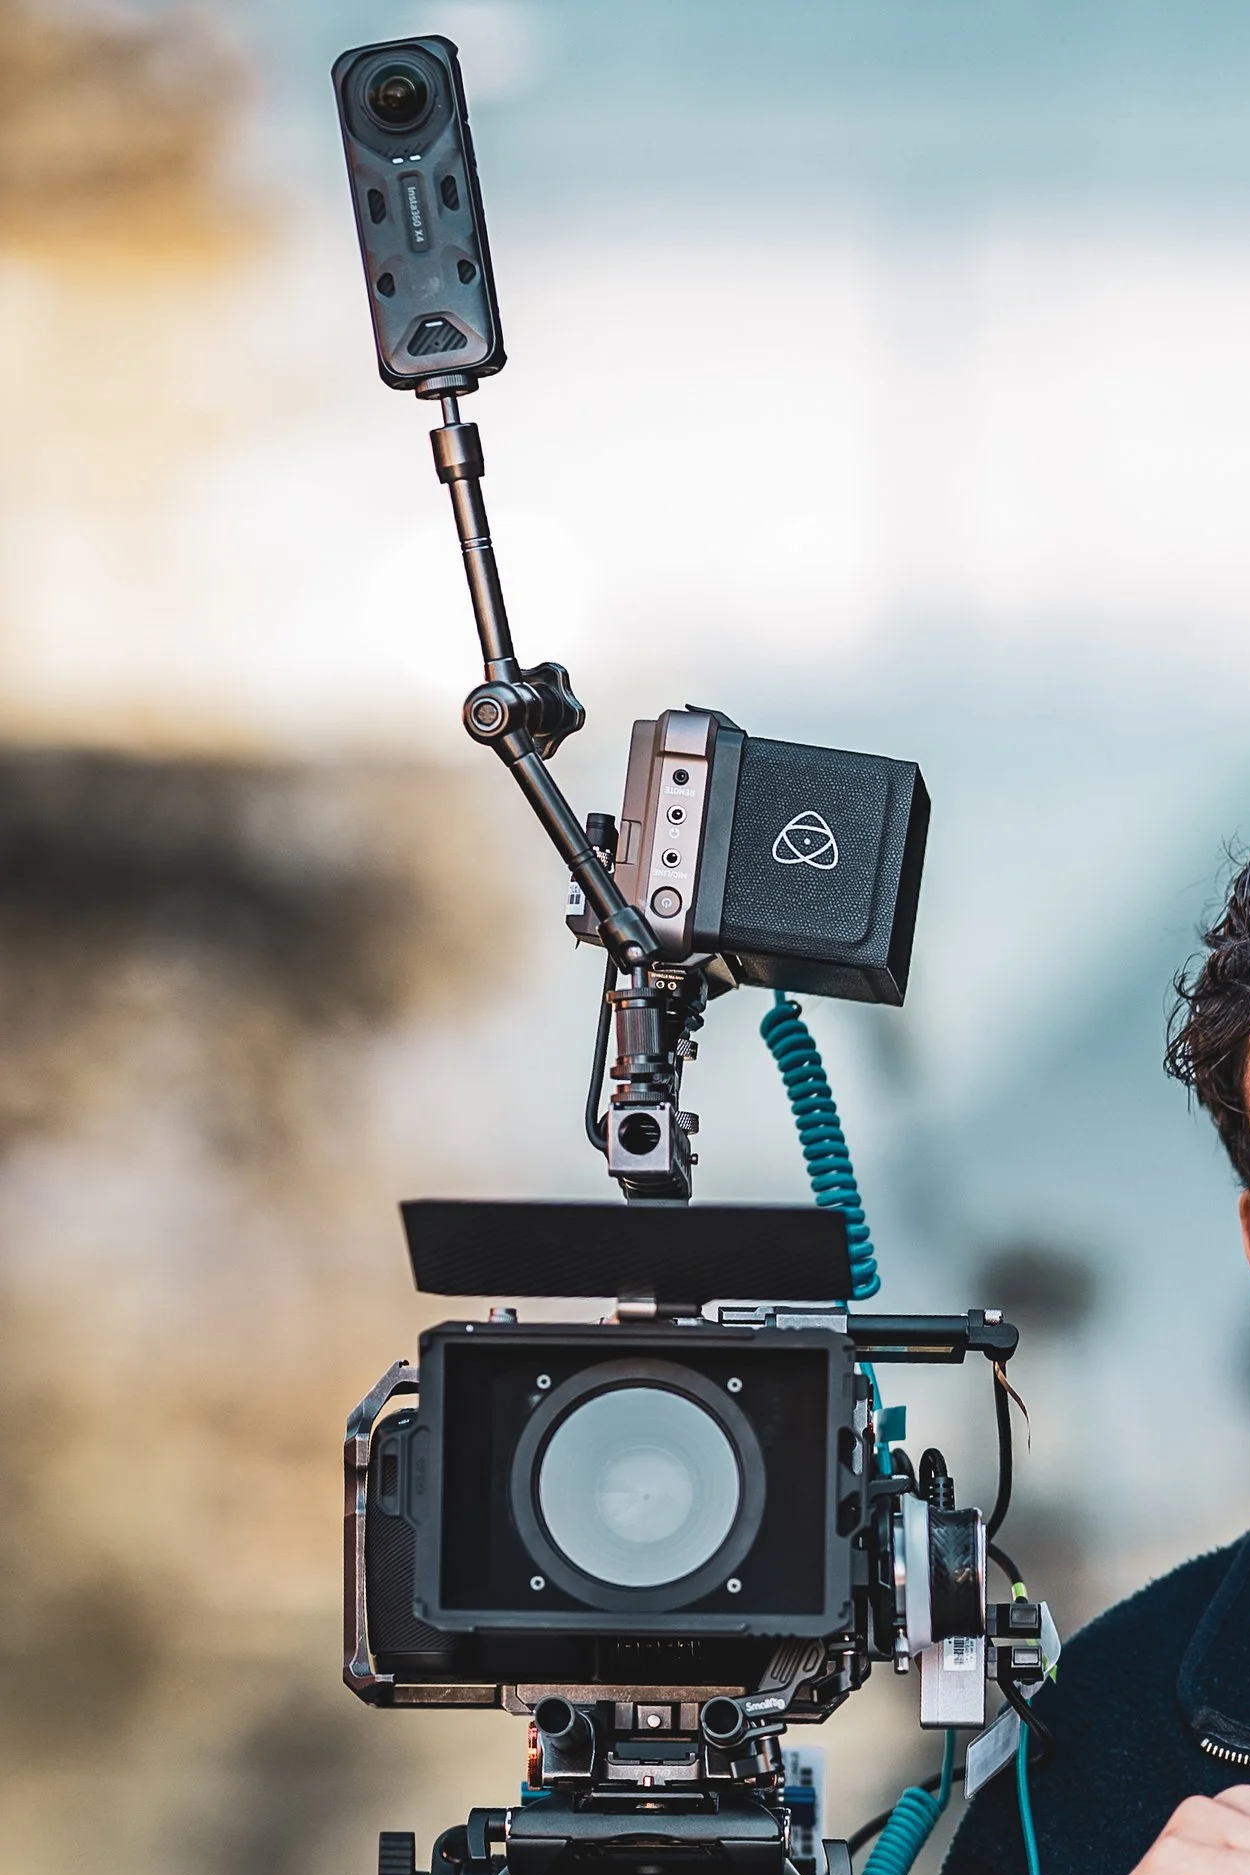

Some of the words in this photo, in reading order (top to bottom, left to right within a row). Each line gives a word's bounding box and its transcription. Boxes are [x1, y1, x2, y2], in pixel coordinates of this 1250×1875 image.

[407, 186, 422, 227] Insta360
[414, 229, 425, 243] X4
[663, 785, 696, 798] REMOTE
[652, 867, 688, 880] MIC/LINE
